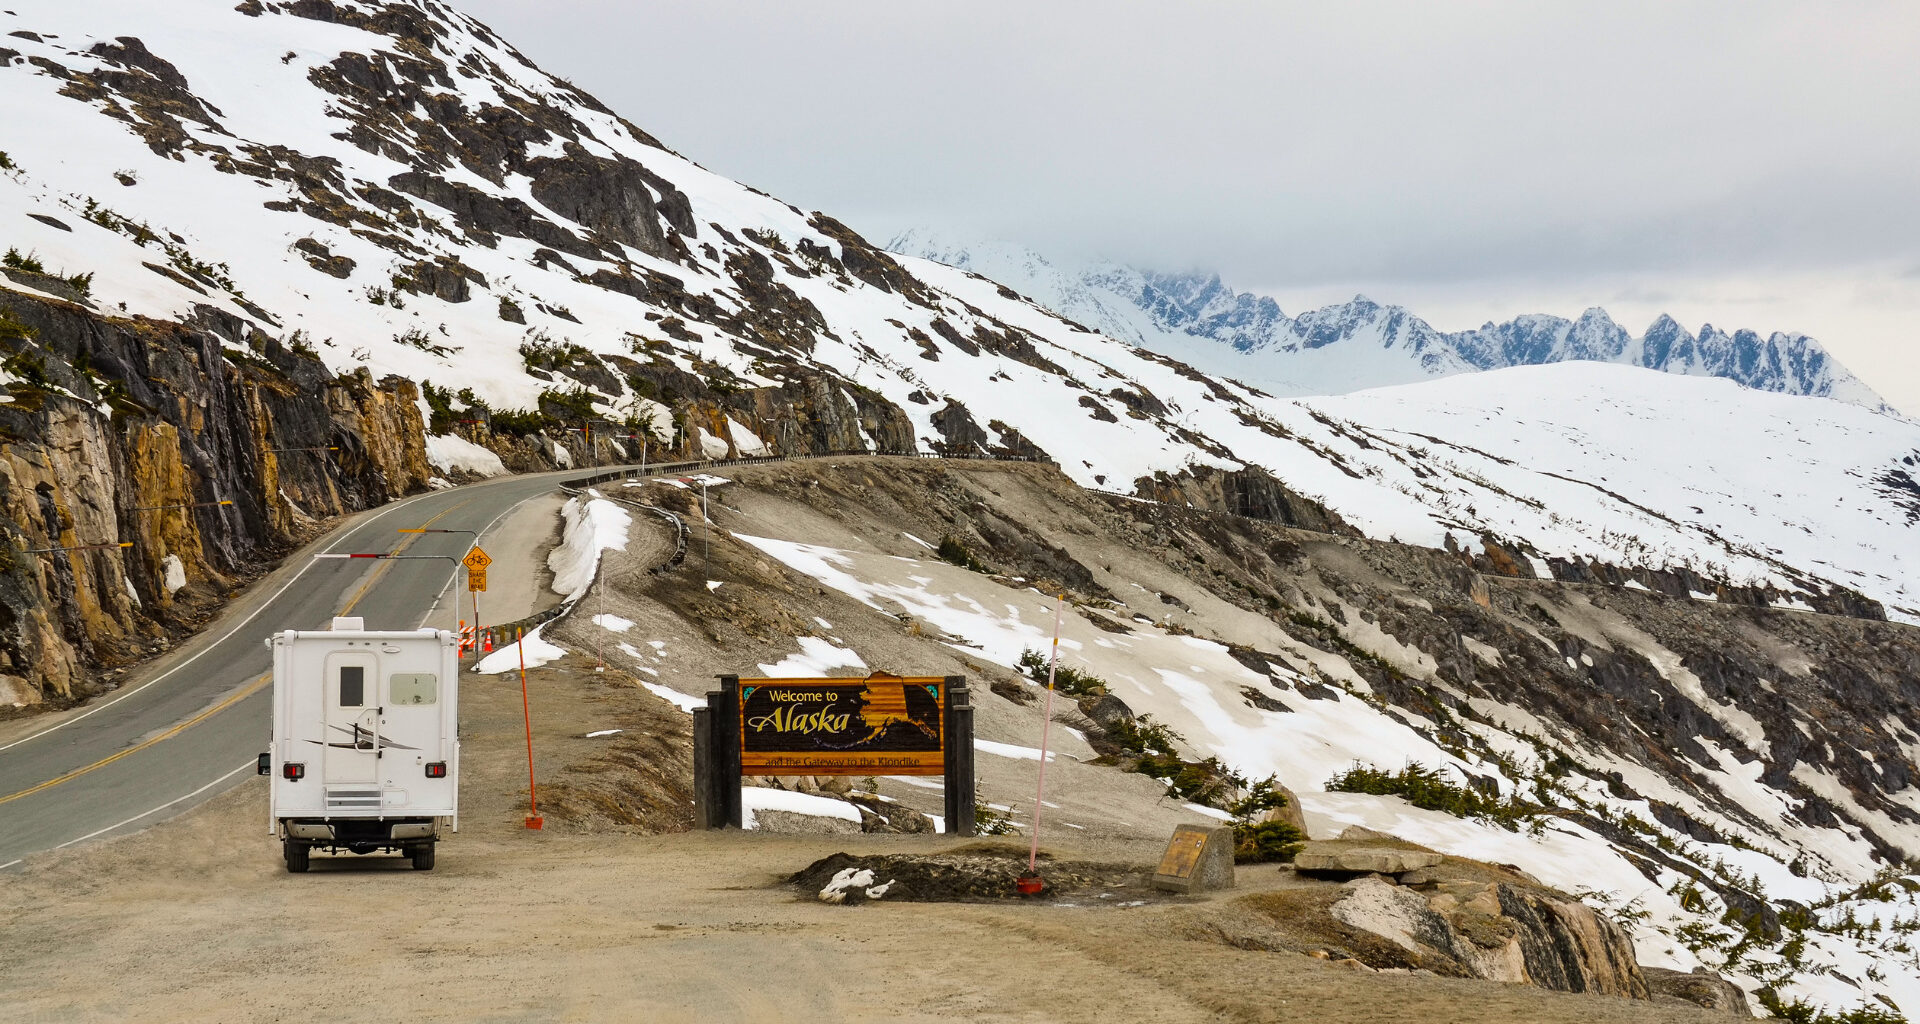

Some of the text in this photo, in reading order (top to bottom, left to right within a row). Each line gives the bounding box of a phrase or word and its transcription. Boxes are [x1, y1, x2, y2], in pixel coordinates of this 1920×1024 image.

[769, 690, 838, 701] Welcome to
[748, 703, 850, 734] Alaska
[766, 756, 920, 768] and the Gateway to the Klondike
